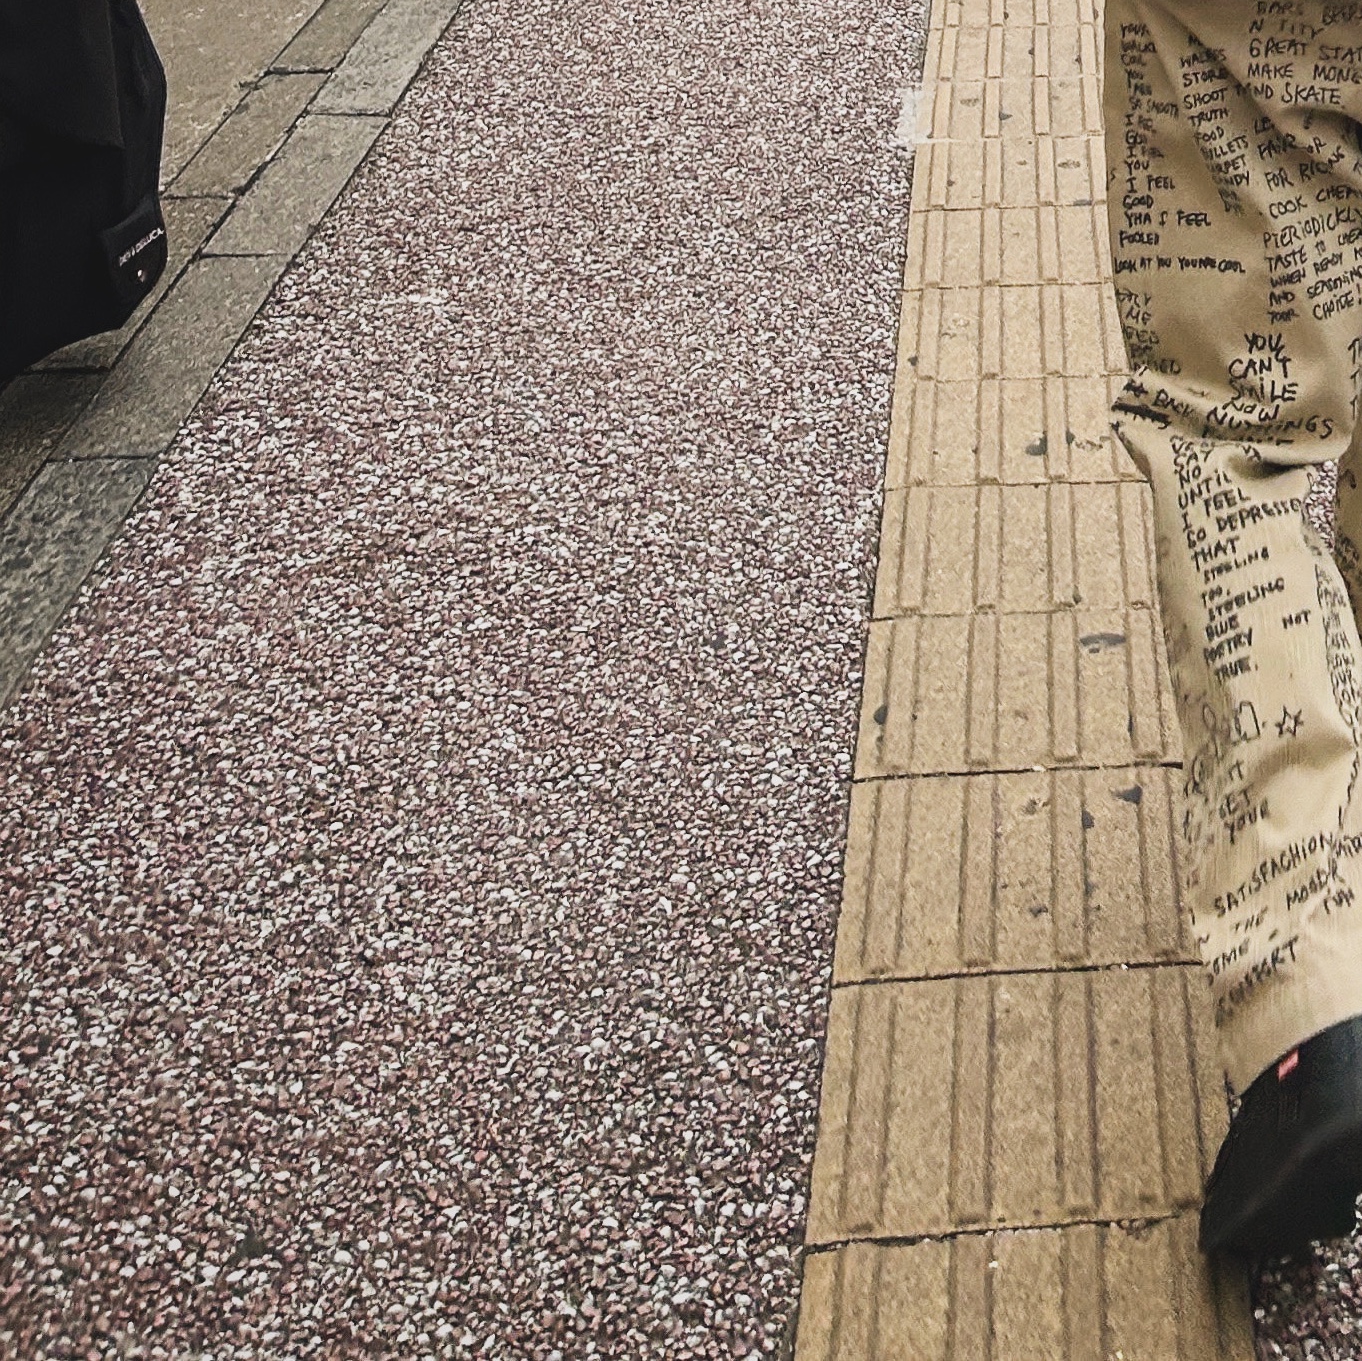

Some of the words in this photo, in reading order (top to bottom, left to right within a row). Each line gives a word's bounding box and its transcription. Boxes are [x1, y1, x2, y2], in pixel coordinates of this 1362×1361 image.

[1248, 62, 1294, 80] MAKE
[1184, 88, 1228, 111] SHOOT
[1188, 108, 1229, 127] TRUTH
[1147, 176, 1175, 190] FEEL
[1265, 167, 1294, 191] FOR
[1269, 194, 1307, 219] COOK
[1265, 244, 1307, 273] TASTE
